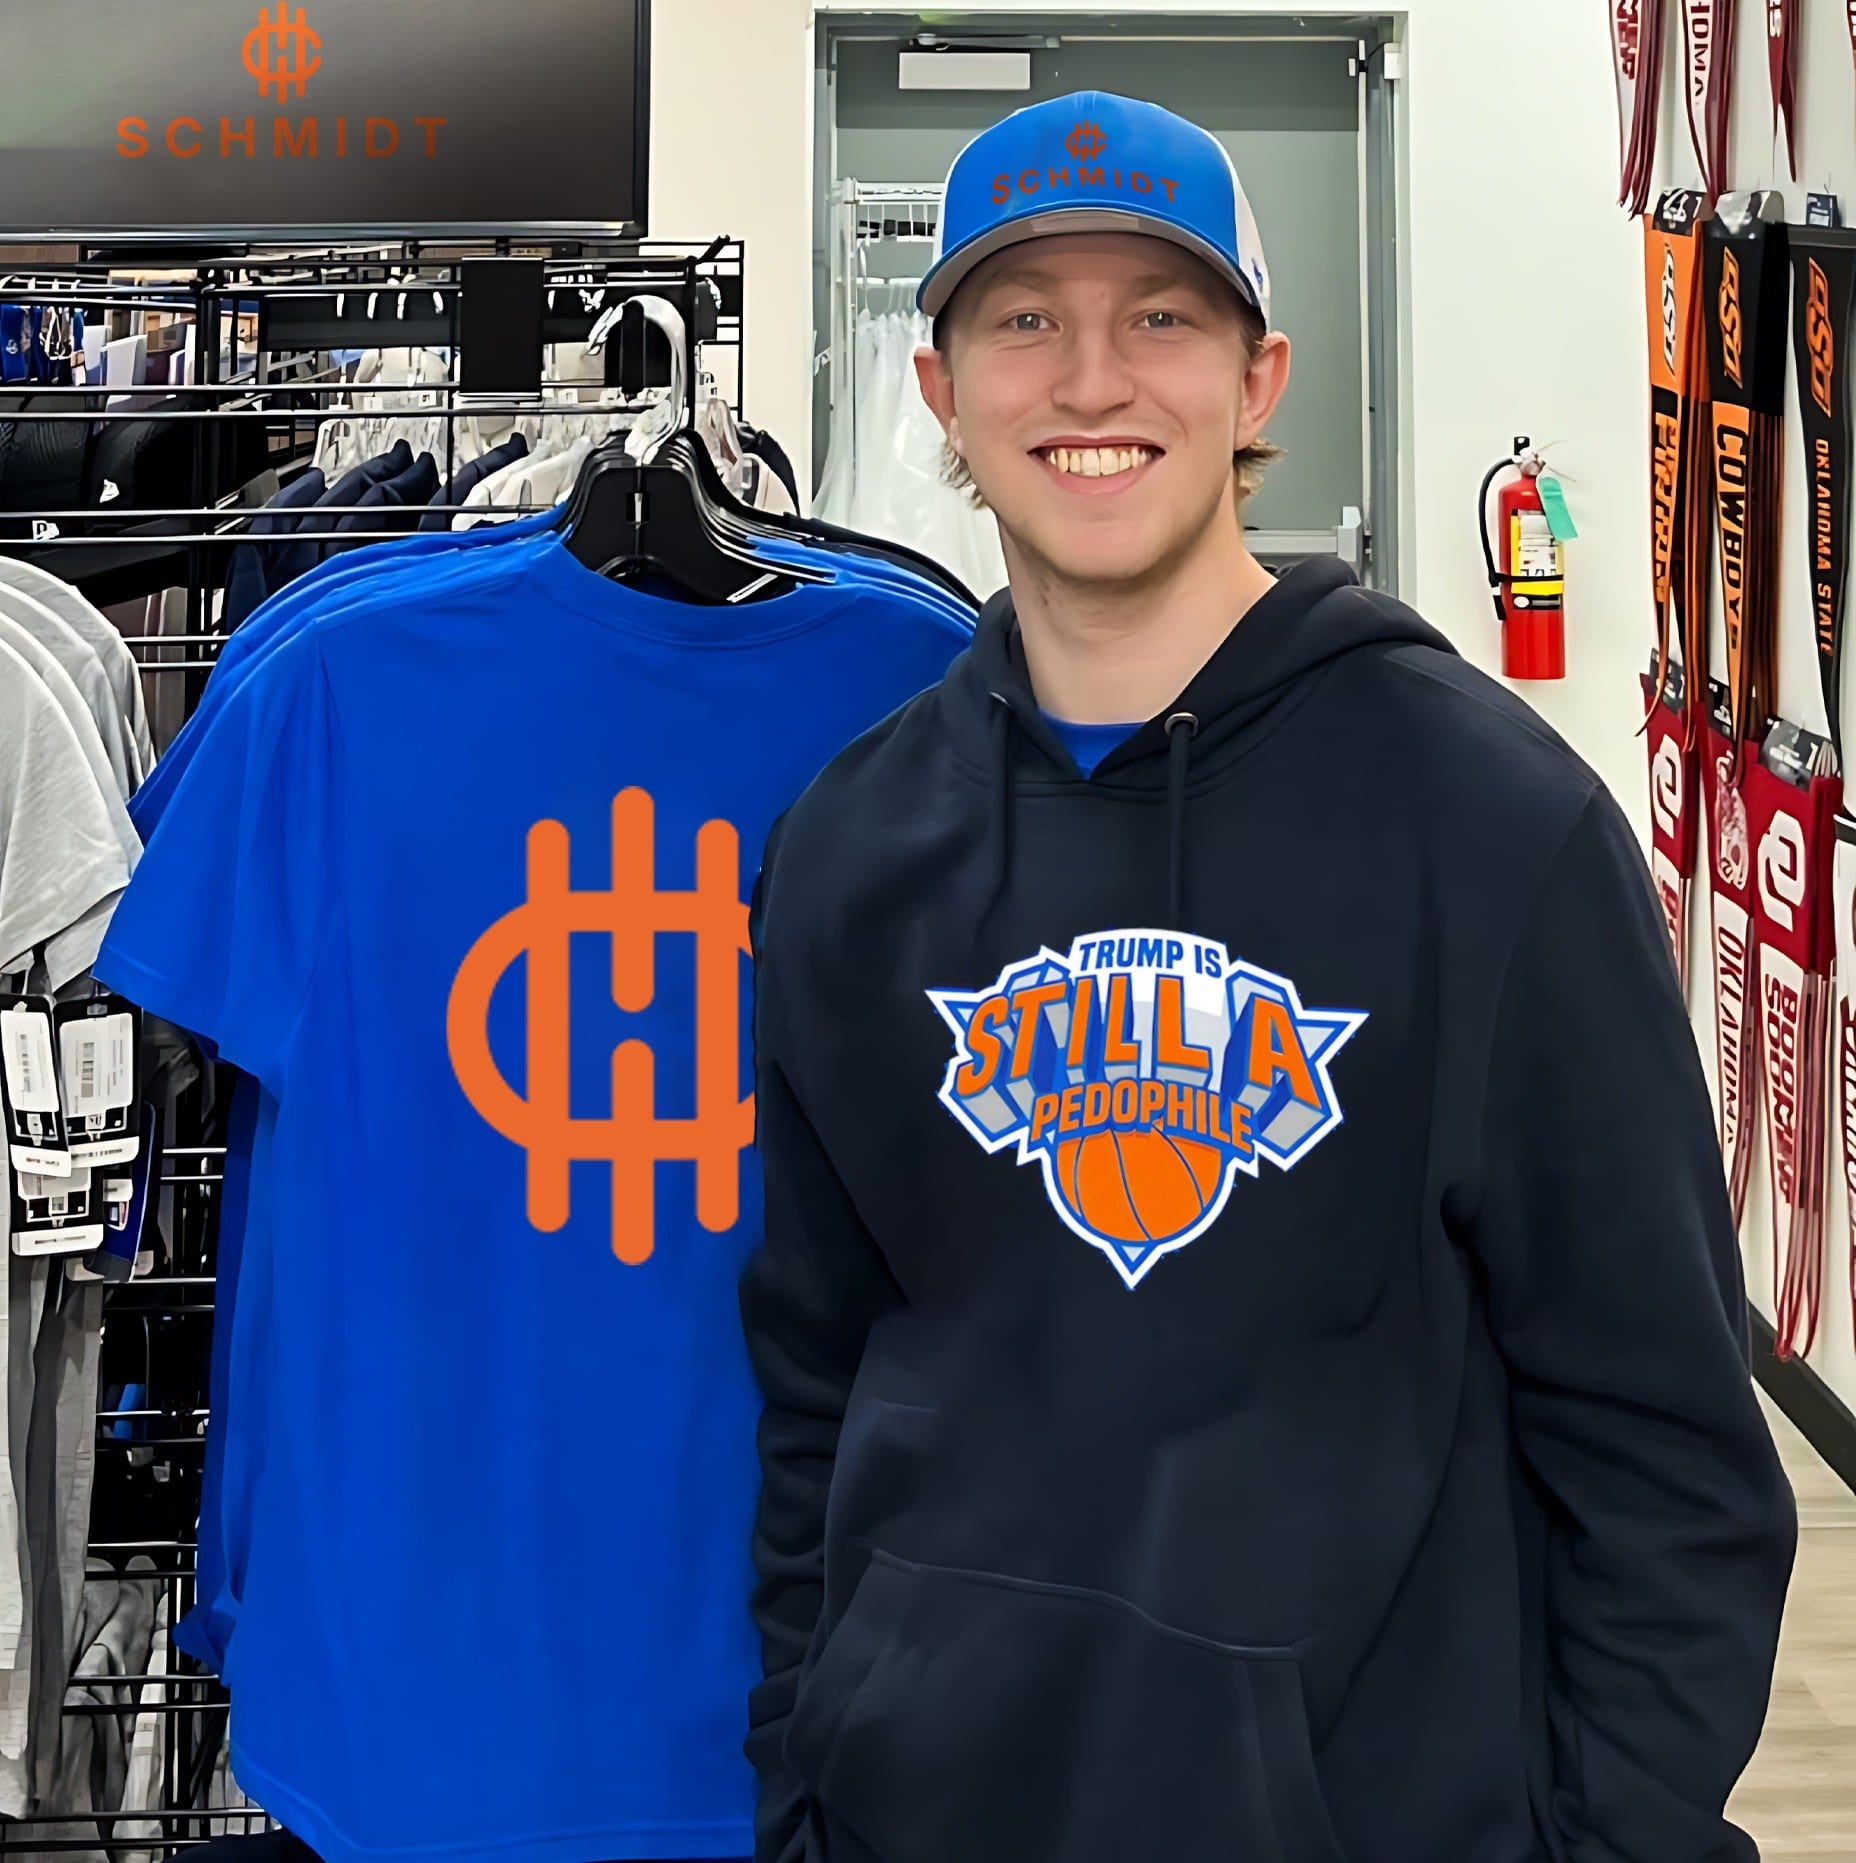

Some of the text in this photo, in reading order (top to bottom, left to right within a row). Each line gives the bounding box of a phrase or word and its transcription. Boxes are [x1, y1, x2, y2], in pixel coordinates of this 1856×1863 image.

[115, 116, 447, 159] SCHMIDT
[991, 167, 1179, 204] SCHMIDT
[1815, 438, 1832, 570] OKLAHOMA
[1079, 937, 1223, 979] TRUMP IS
[955, 973, 1322, 1110] STILL A
[1029, 1078, 1254, 1154] PEDOPHILE
